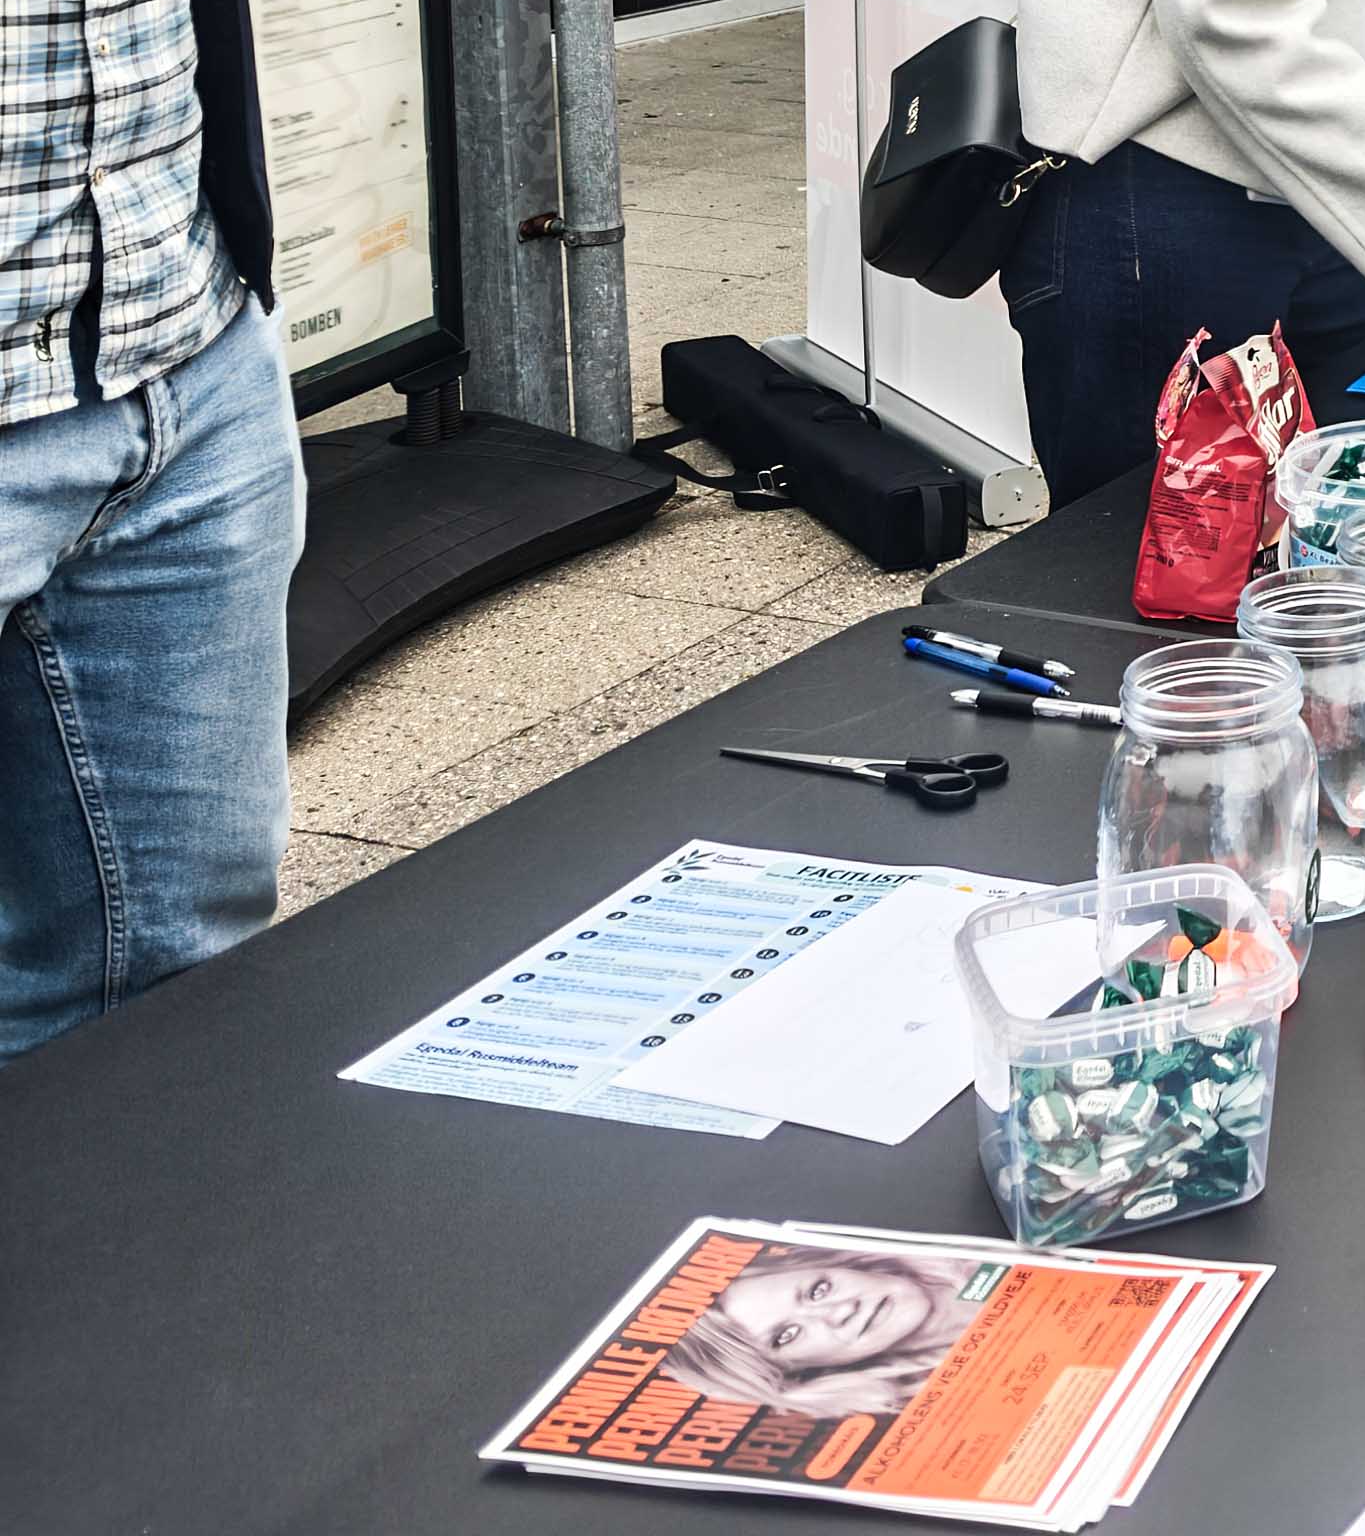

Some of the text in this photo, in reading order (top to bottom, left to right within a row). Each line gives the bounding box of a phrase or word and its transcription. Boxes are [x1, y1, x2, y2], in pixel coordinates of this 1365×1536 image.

[290, 307, 342, 343] BOMBEN
[416, 1041, 580, 1073] Egedal Rusmiddelteam
[518, 1235, 765, 1454] PERNILLE HØJMARK
[863, 1387, 943, 1488] ALKOHOLENS
[939, 1353, 971, 1391] VEJE
[966, 1329, 988, 1354] OG
[979, 1270, 1034, 1337] VILDVEJE
